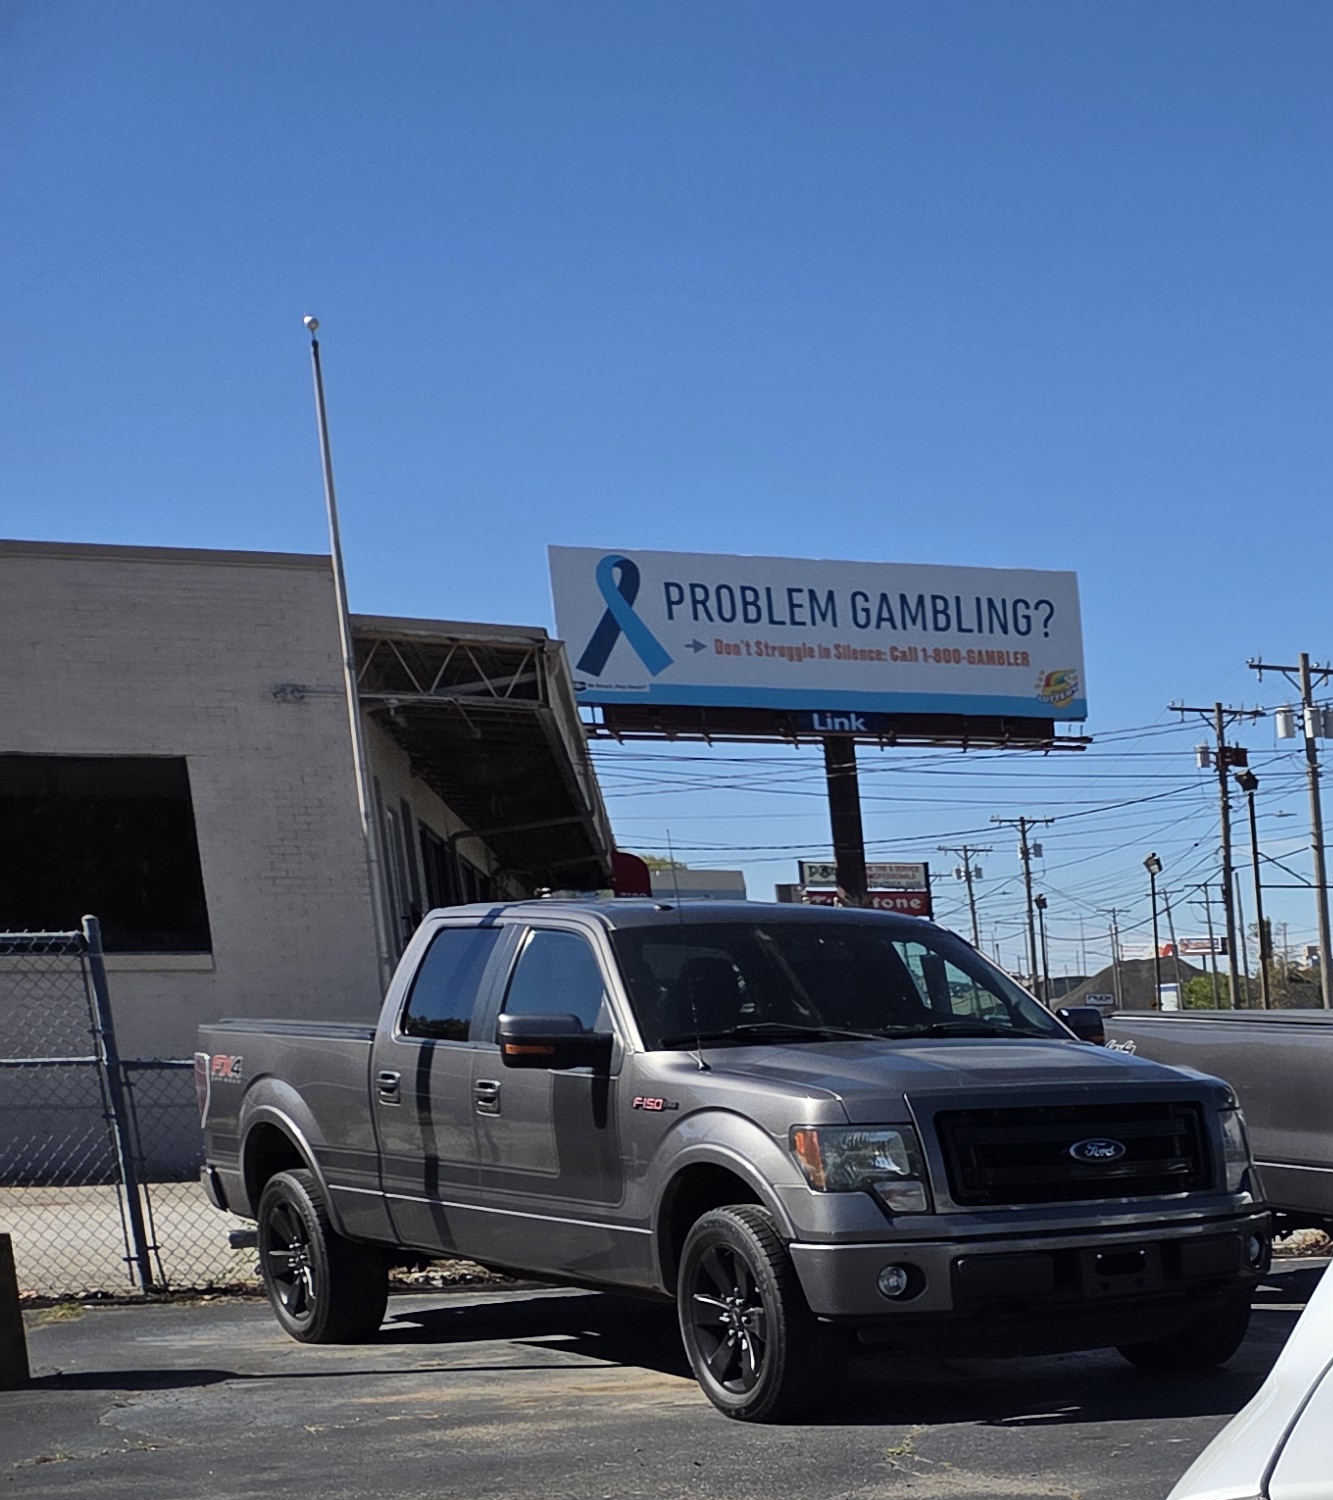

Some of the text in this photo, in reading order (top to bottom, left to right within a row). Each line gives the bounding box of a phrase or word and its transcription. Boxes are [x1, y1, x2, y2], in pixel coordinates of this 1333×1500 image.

[663, 581, 1056, 639] PROBLEM GAMBLING?
[714, 638, 752, 657] Don't
[754, 640, 816, 662] Struggle
[889, 646, 919, 663] Call
[921, 647, 1031, 668] 1-800-GAMBLER
[813, 712, 866, 732] Link
[211, 1054, 244, 1078] FX4
[1084, 1142, 1116, 1157] Ford
